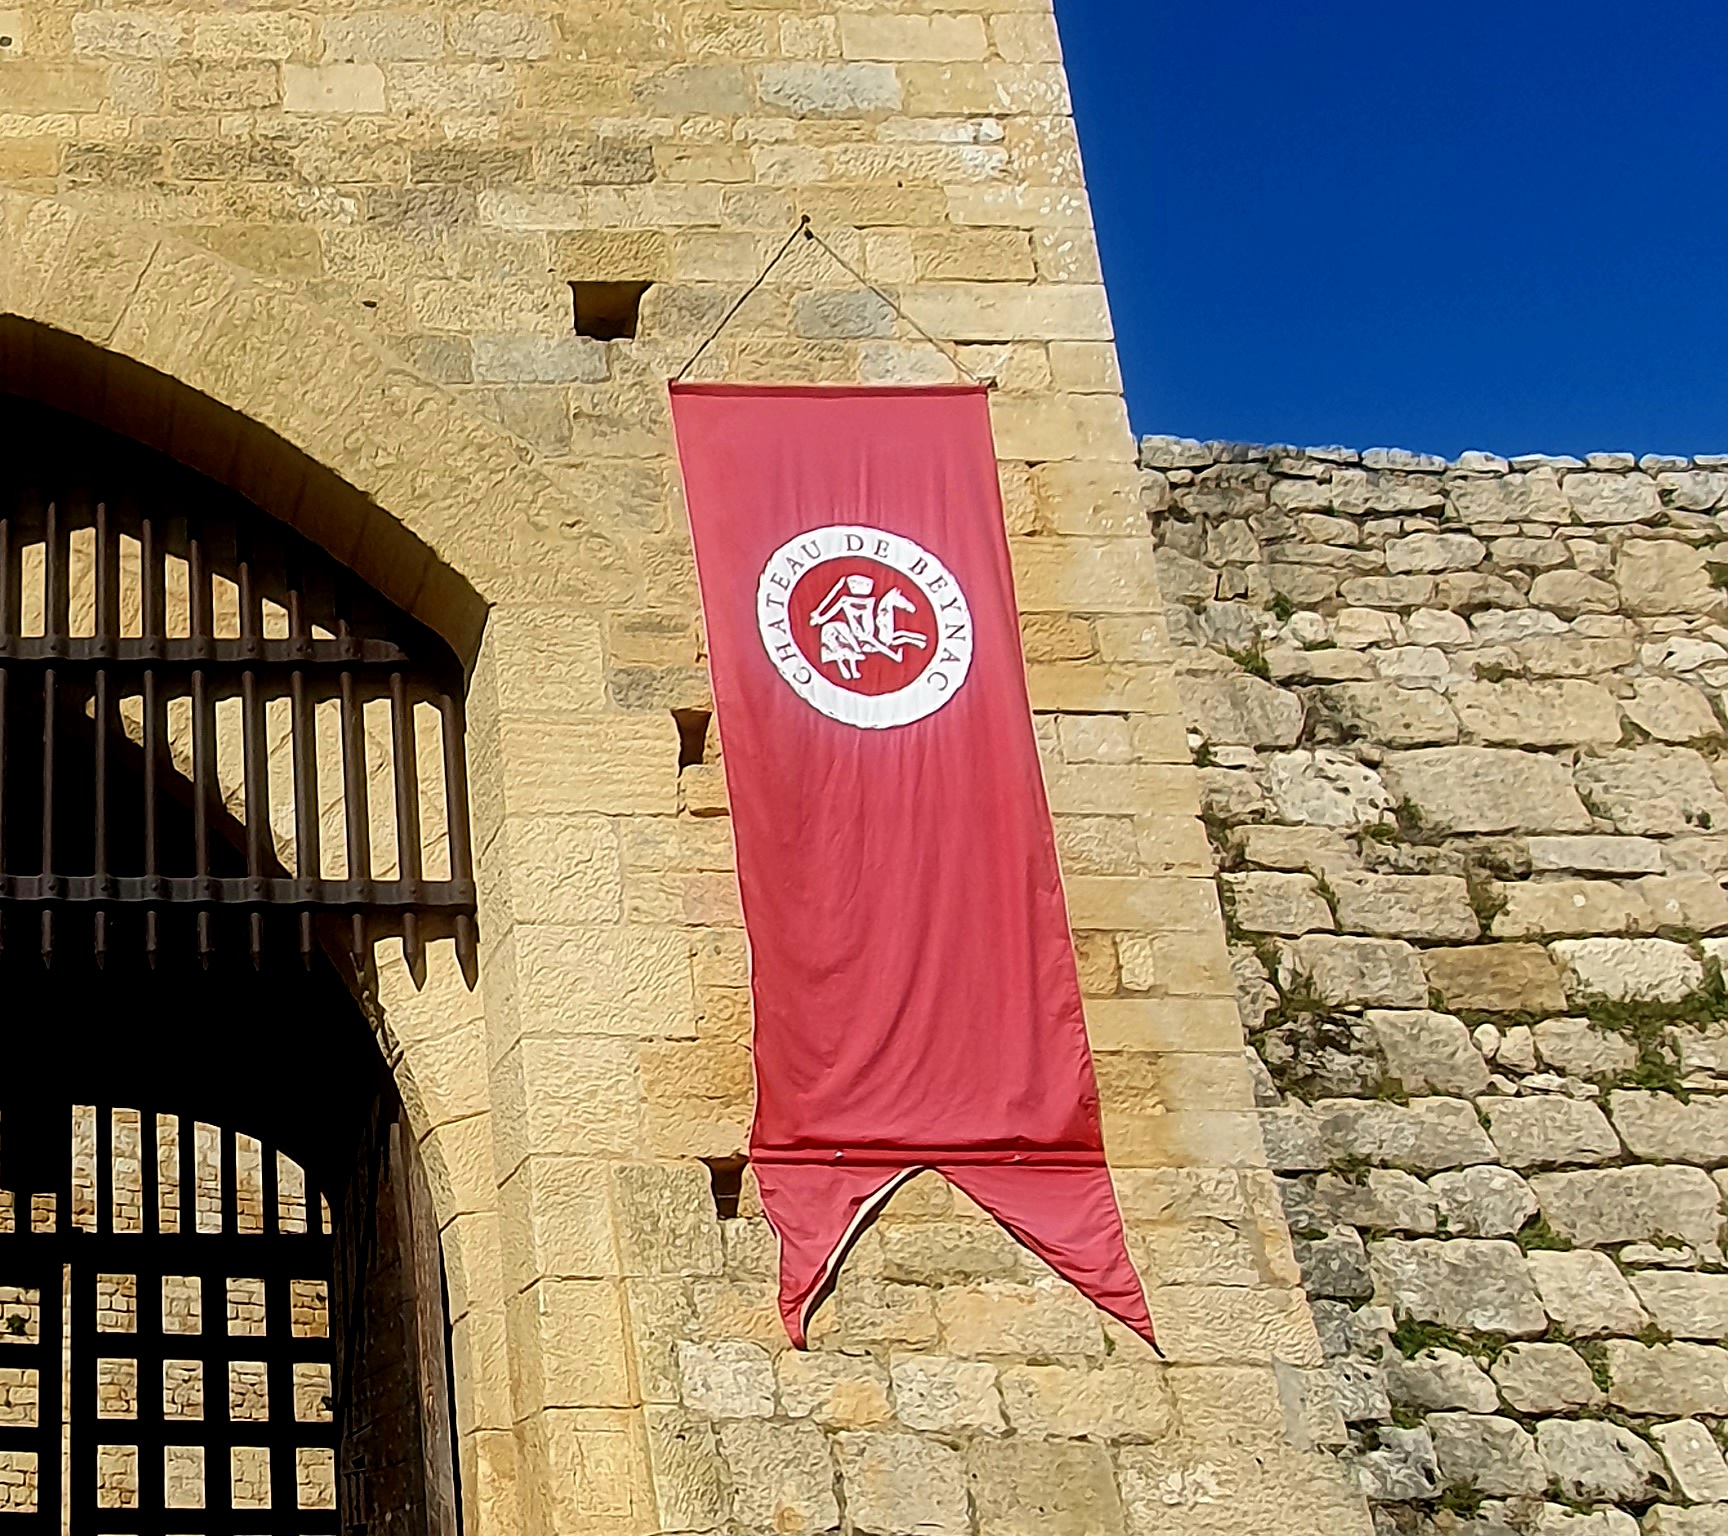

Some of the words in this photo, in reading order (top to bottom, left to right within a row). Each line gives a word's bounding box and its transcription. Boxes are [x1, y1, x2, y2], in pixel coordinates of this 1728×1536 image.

[766, 539, 822, 686] CHATEAU
[845, 533, 891, 560] DE
[909, 556, 967, 693] BEYNAC
